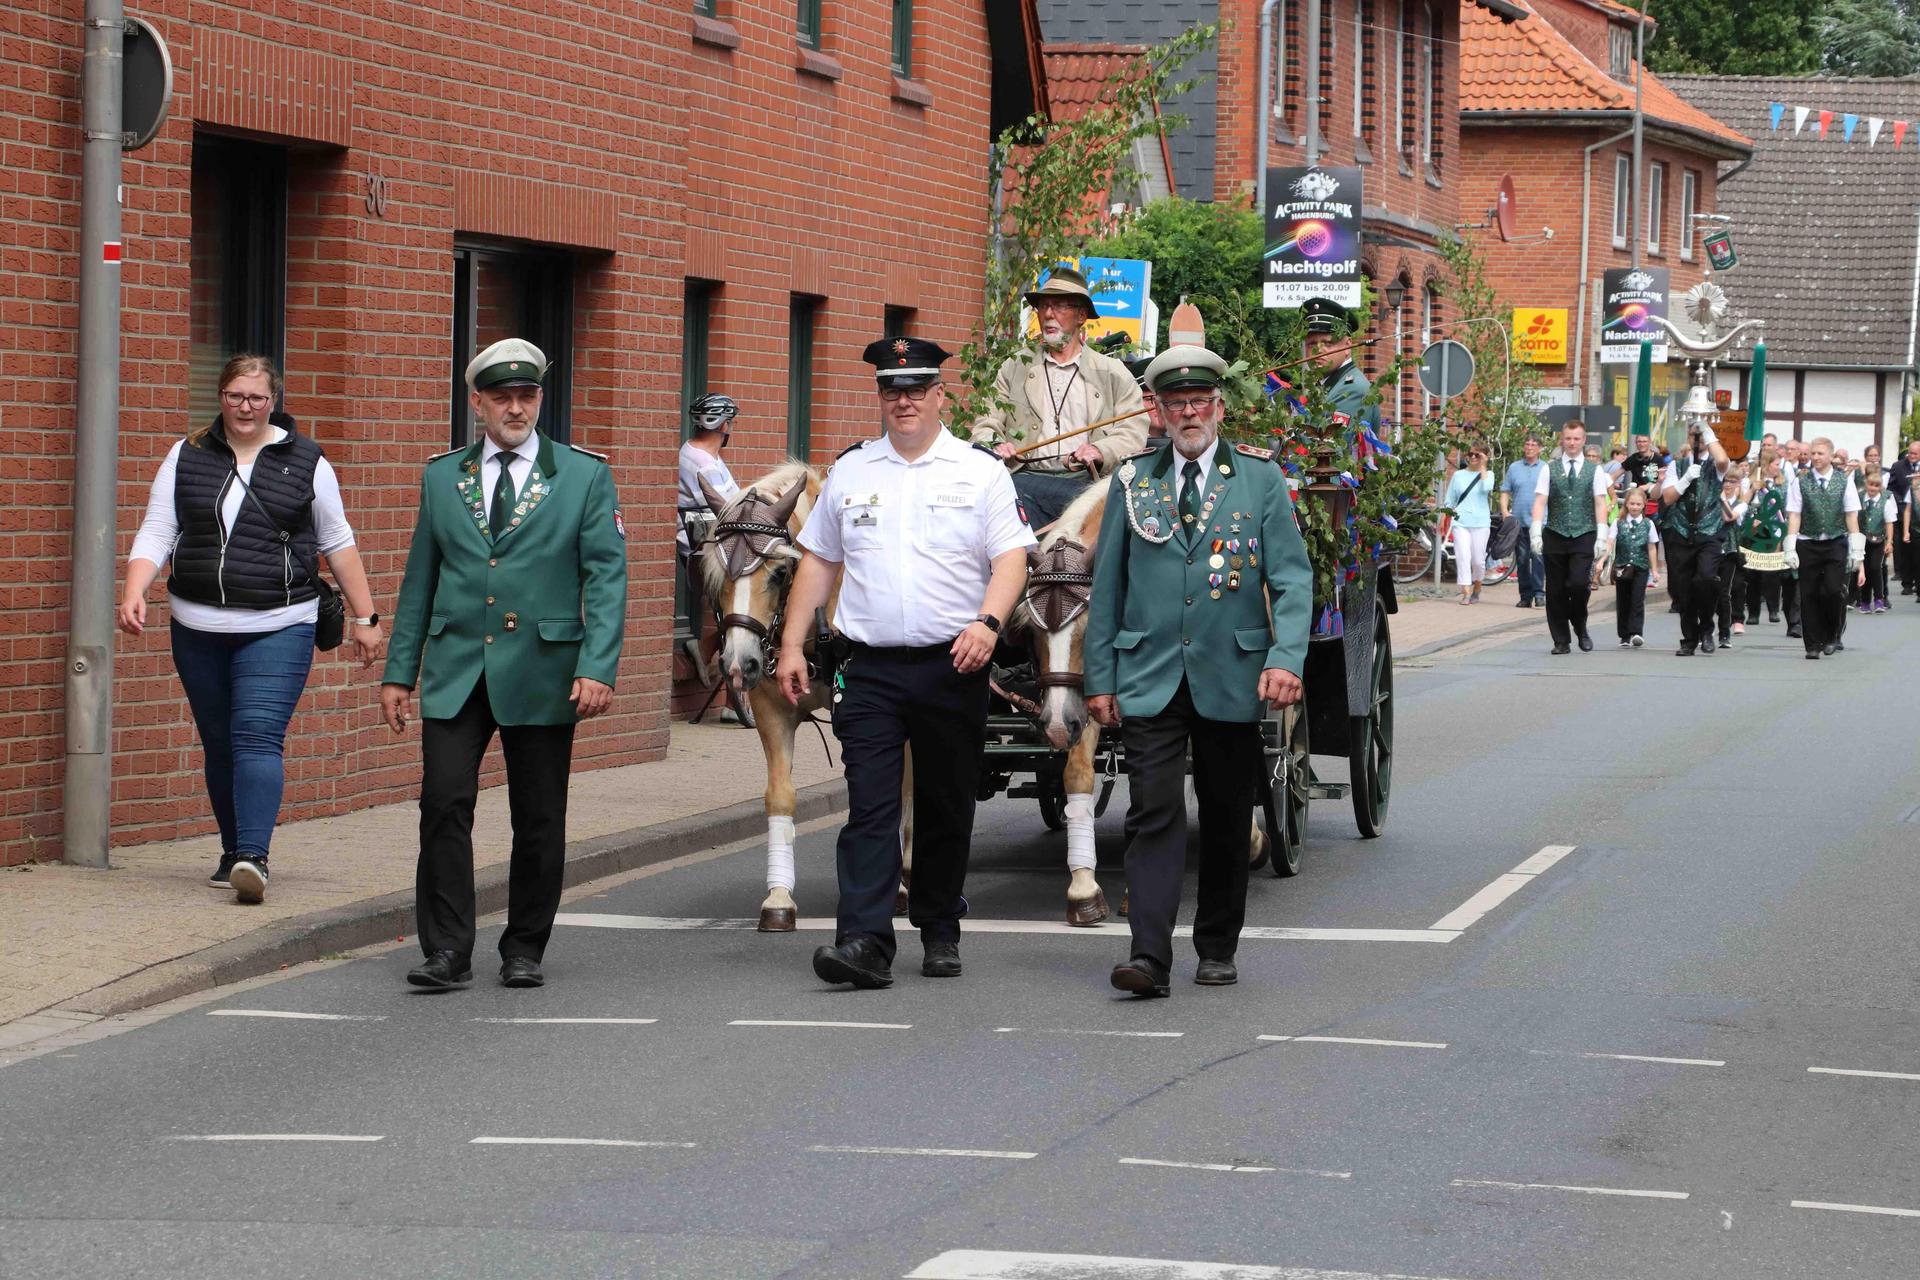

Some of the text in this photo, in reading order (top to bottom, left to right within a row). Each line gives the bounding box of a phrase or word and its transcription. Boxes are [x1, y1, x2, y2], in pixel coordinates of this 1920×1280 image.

[366, 173, 386, 216] 30
[1274, 201, 1353, 219] ACTIVITY PARK
[1291, 211, 1336, 220] HAGENBURG
[1270, 260, 1357, 277] Nachtgolf
[1275, 283, 1350, 292] 11.07 bis 20.09
[1609, 291, 1663, 304] ACTIVITY PARK
[1520, 339, 1559, 350] LOTTO
[937, 495, 966, 504] POLIZEI
